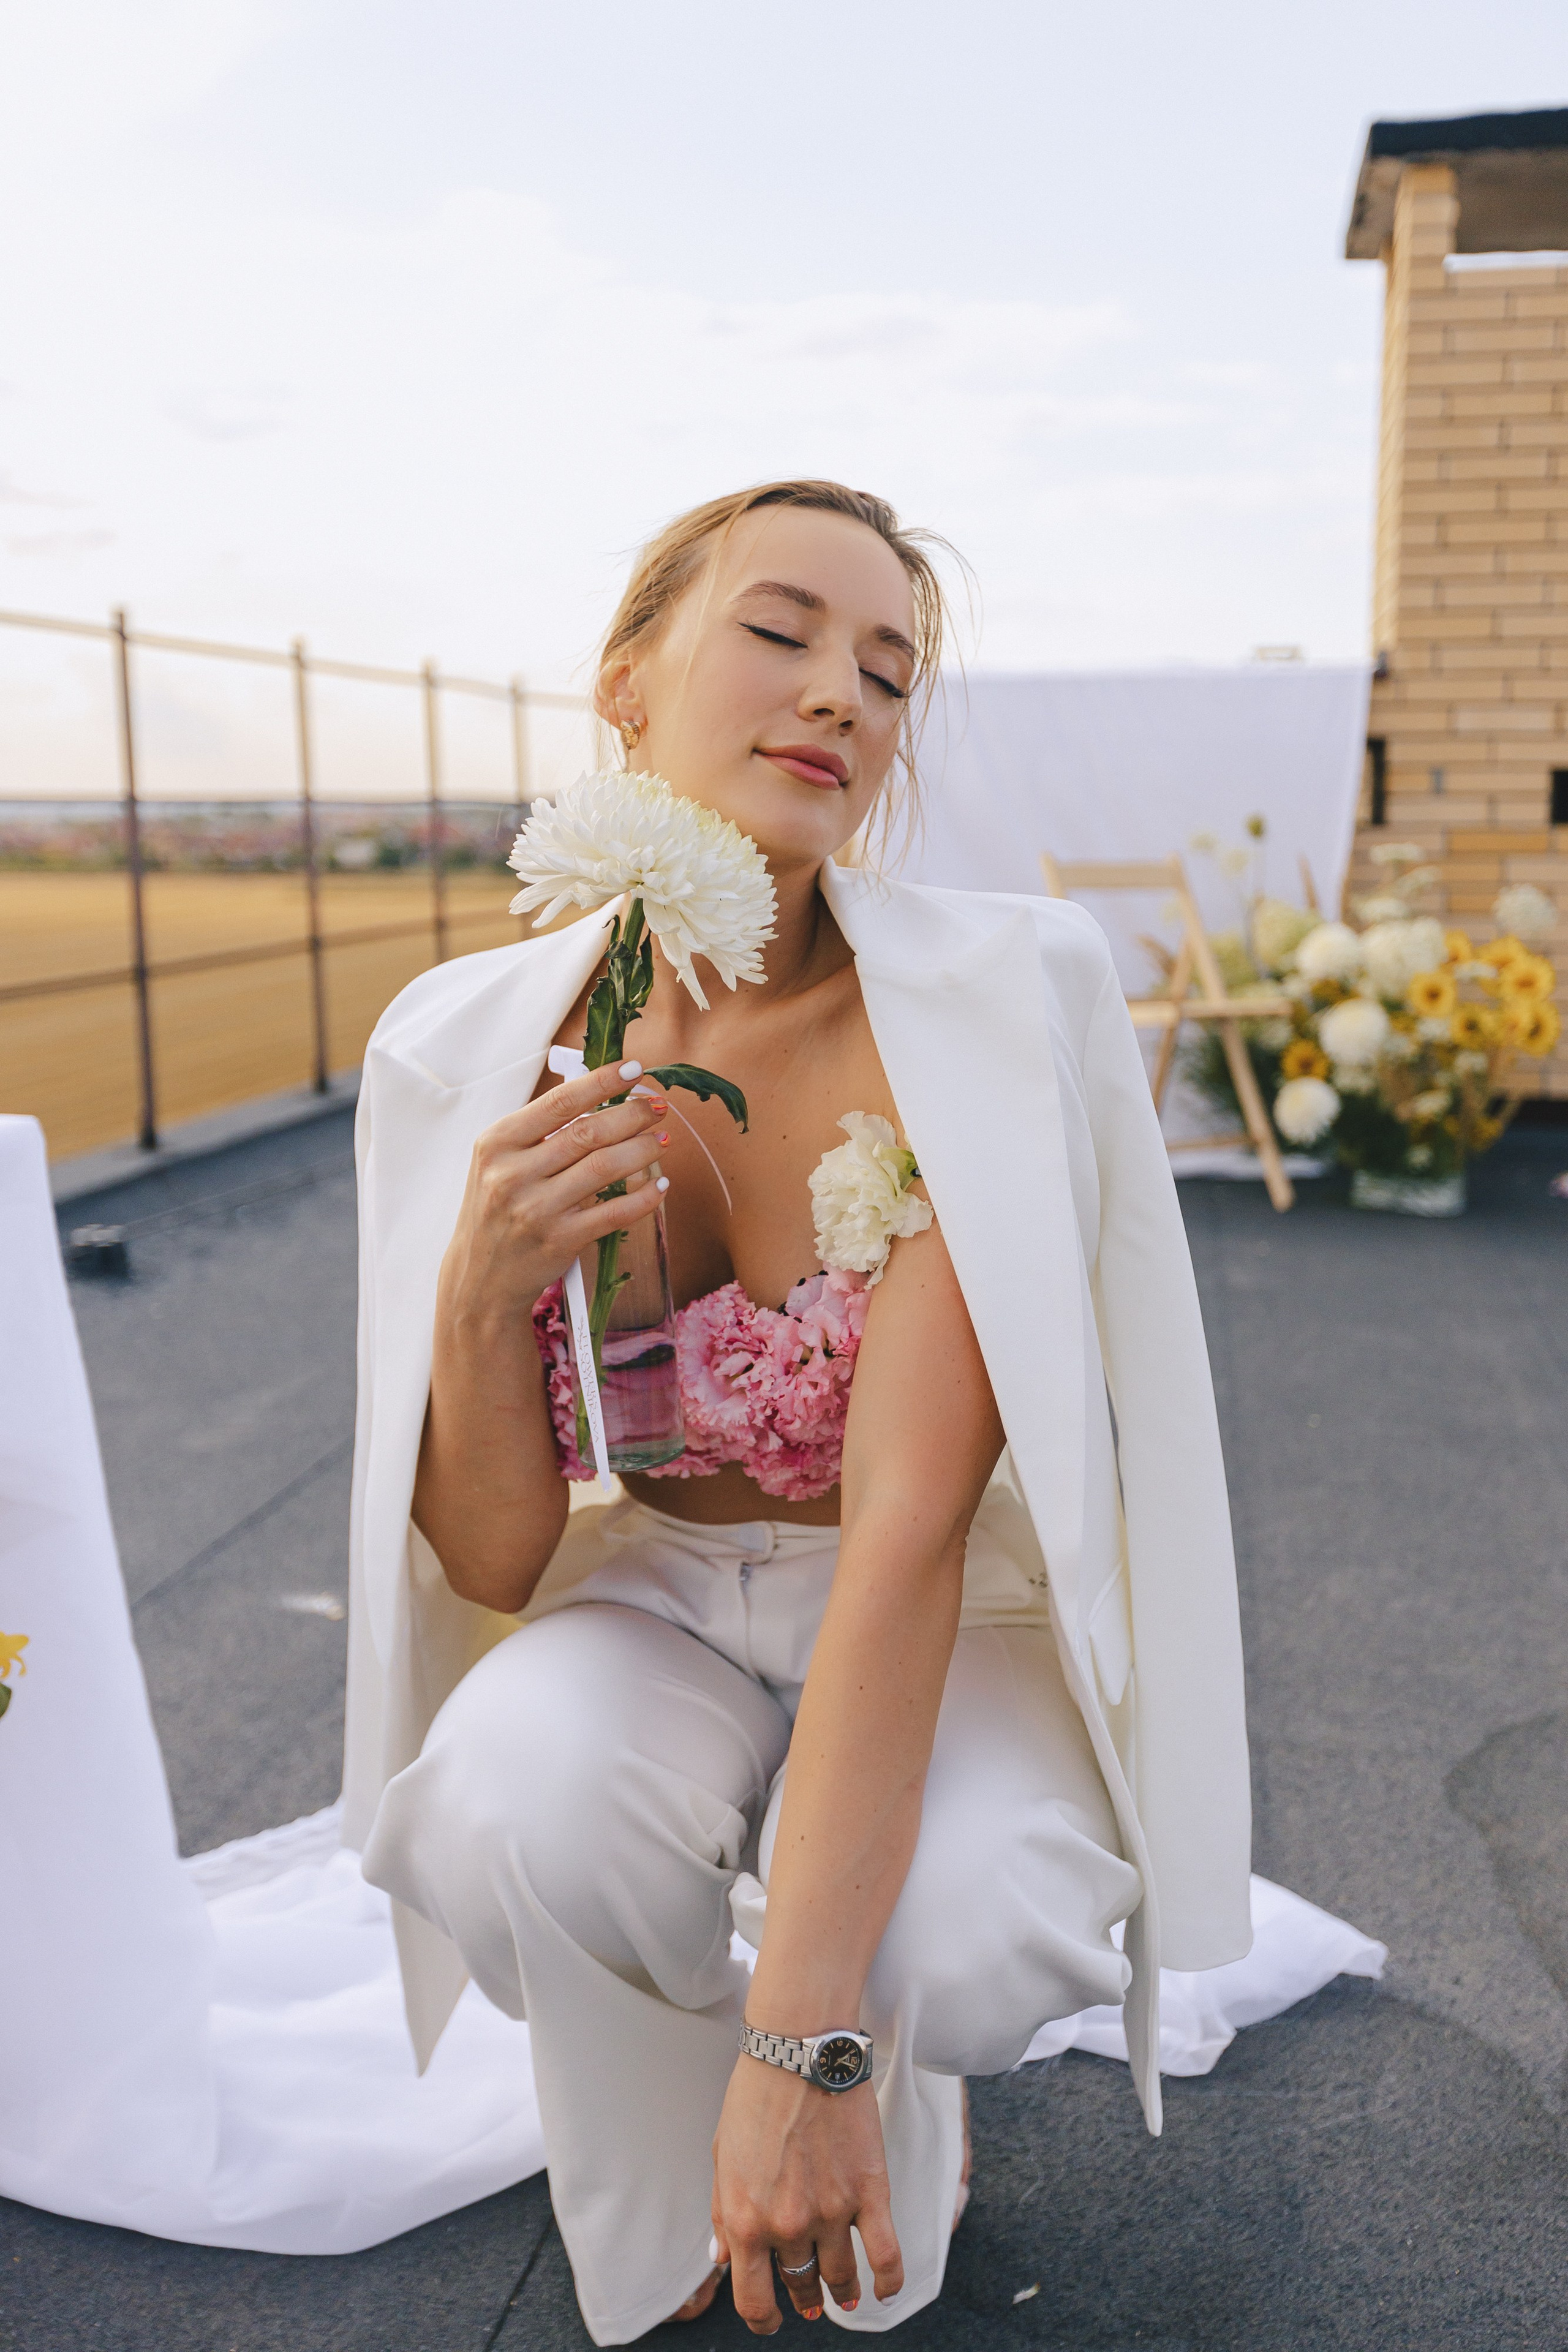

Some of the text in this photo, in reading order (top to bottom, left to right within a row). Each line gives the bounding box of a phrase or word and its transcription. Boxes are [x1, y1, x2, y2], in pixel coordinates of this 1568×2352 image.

[580, 1353, 599, 1442] SOTNIKOVA
[582, 1335, 598, 1410] FLOWERS
[851, 2056, 858, 2065] 12
